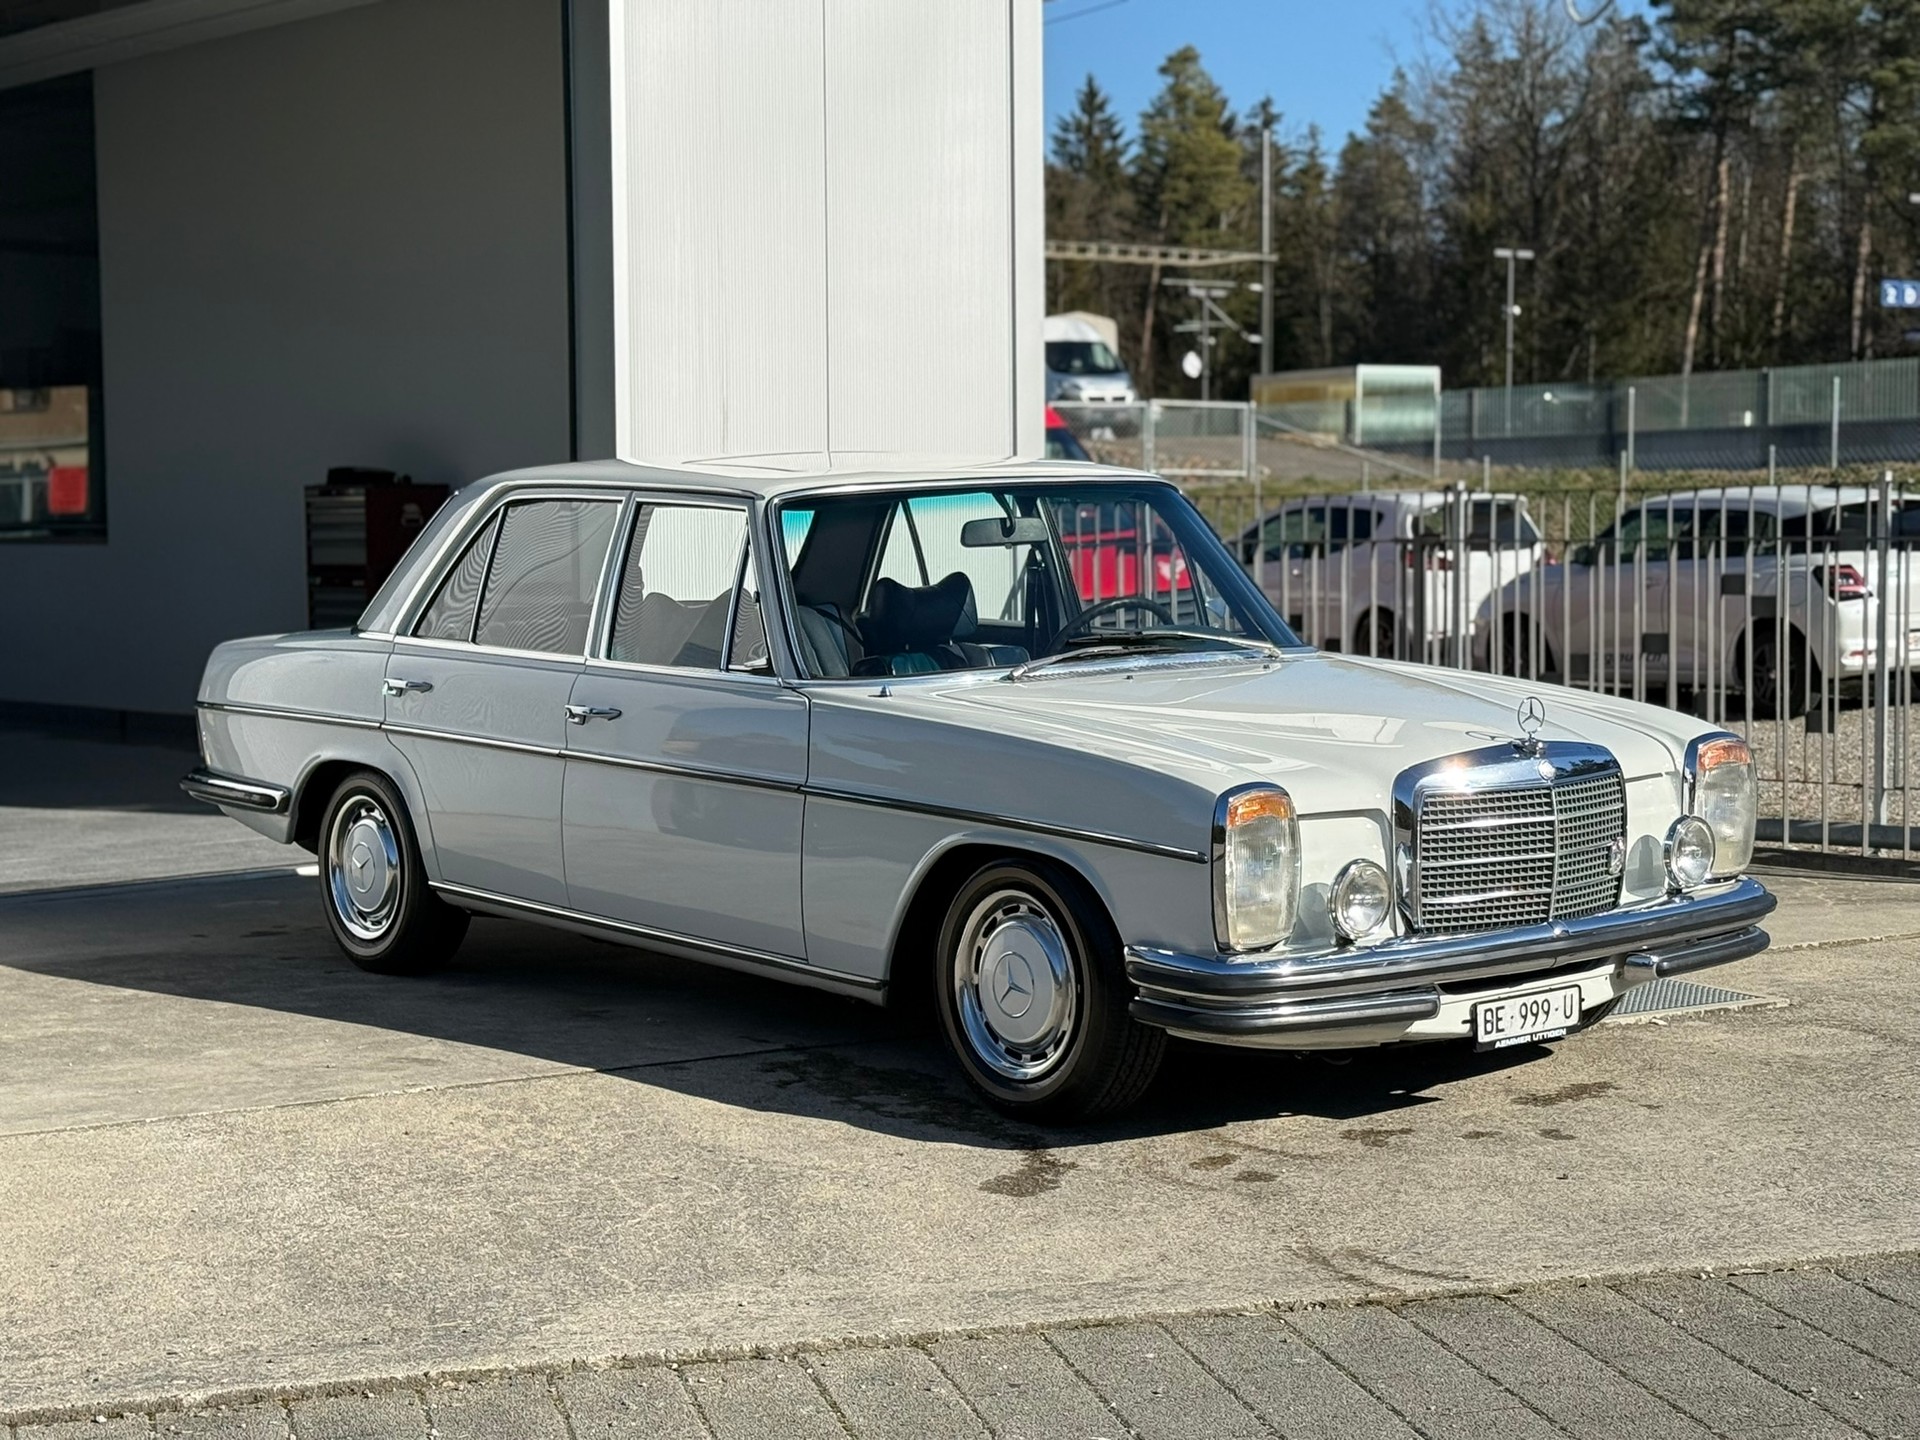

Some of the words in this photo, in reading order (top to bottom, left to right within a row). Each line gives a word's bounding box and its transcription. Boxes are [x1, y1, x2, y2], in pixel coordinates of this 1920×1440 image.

[1483, 1006, 1506, 1035] BE
[1519, 998, 1551, 1030] 999
[1563, 993, 1574, 1020] U
